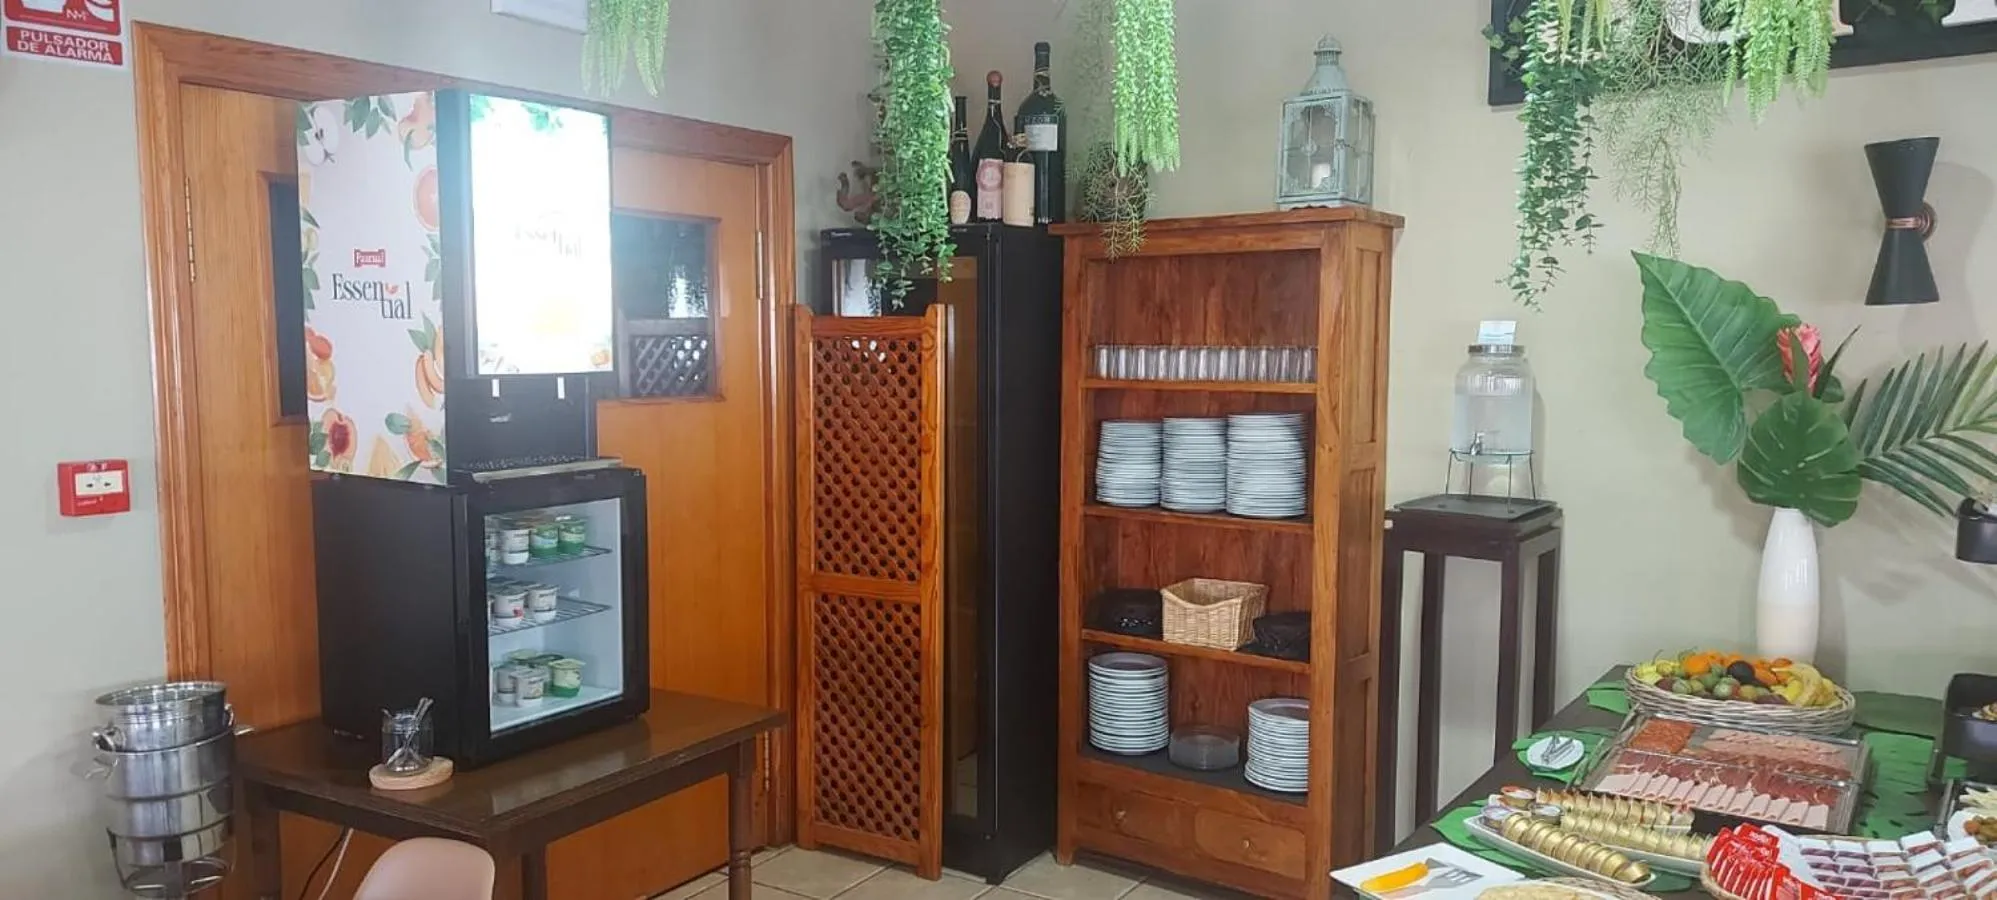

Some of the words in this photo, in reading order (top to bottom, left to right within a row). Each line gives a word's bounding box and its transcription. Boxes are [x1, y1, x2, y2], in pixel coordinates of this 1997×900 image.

[17, 41, 41, 53] DE
[45, 45, 114, 63] ALARMA
[20, 30, 109, 52] PULSADOR
[331, 273, 411, 319] Essential
